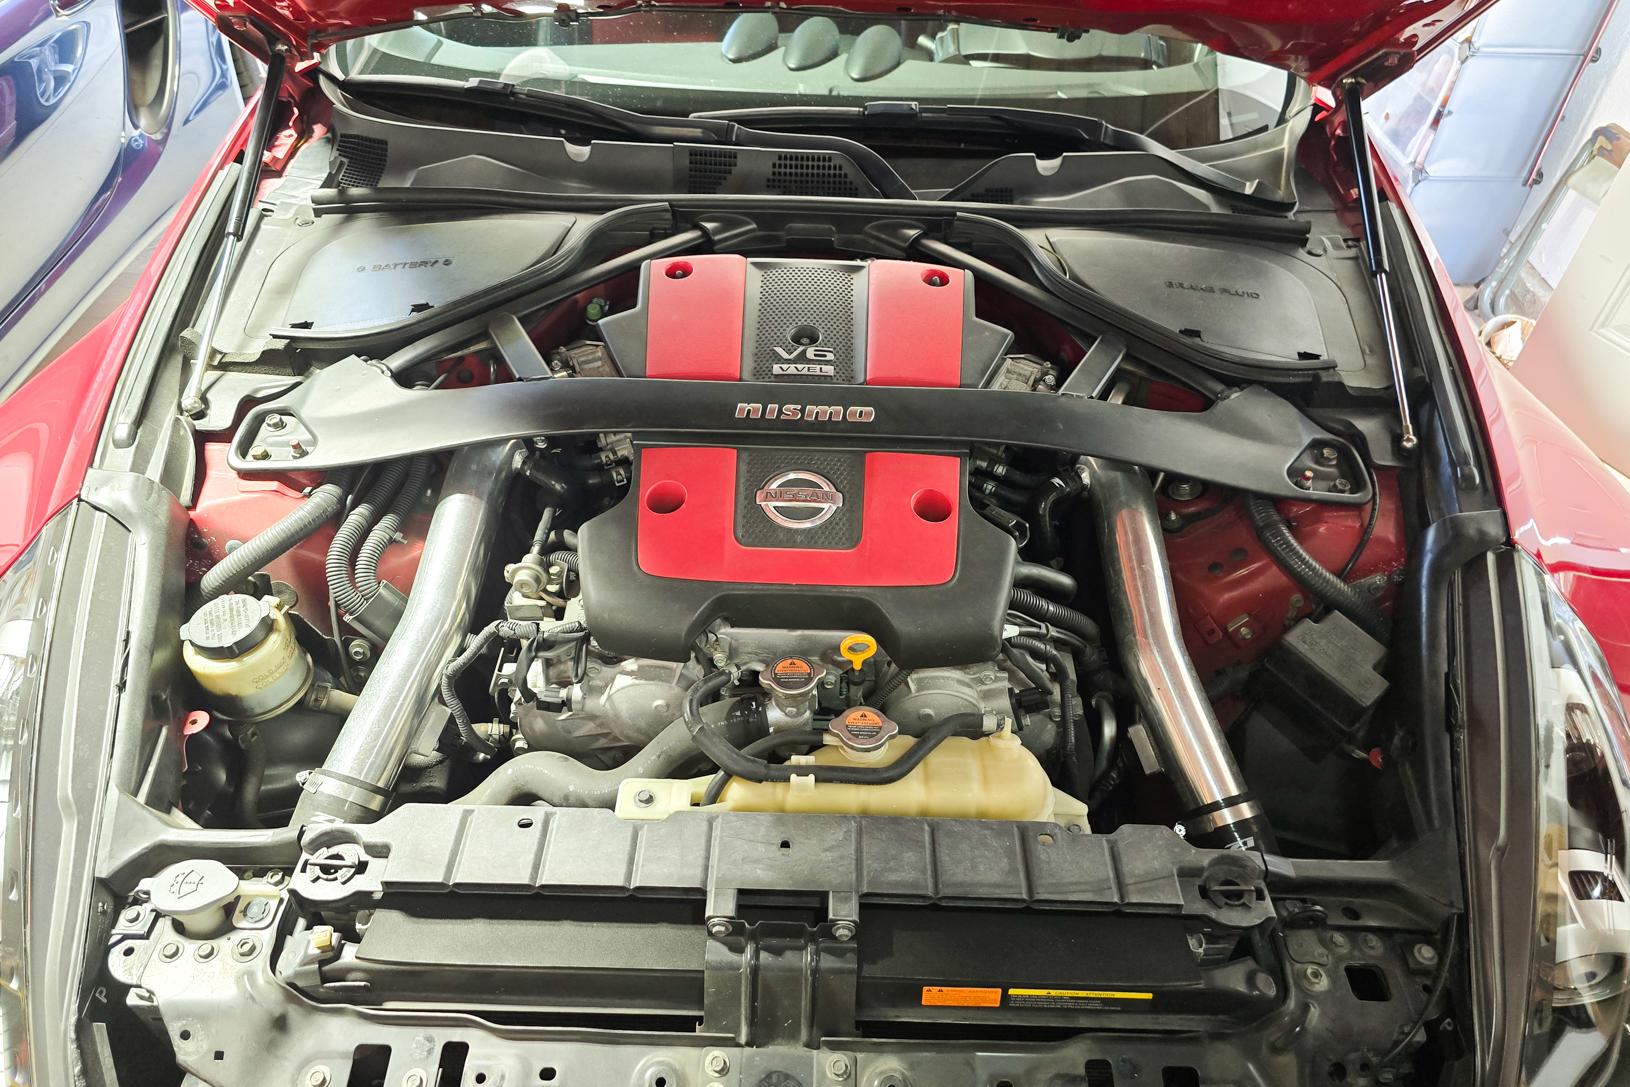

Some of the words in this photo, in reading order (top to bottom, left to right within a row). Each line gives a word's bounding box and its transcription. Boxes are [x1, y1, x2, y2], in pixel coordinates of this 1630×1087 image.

[371, 259, 439, 272] BATTERY
[1219, 287, 1260, 299] FLUID
[772, 345, 835, 361] V6
[778, 365, 829, 374] VVEL
[734, 402, 876, 423] nismo
[765, 490, 833, 501] NISSAN
